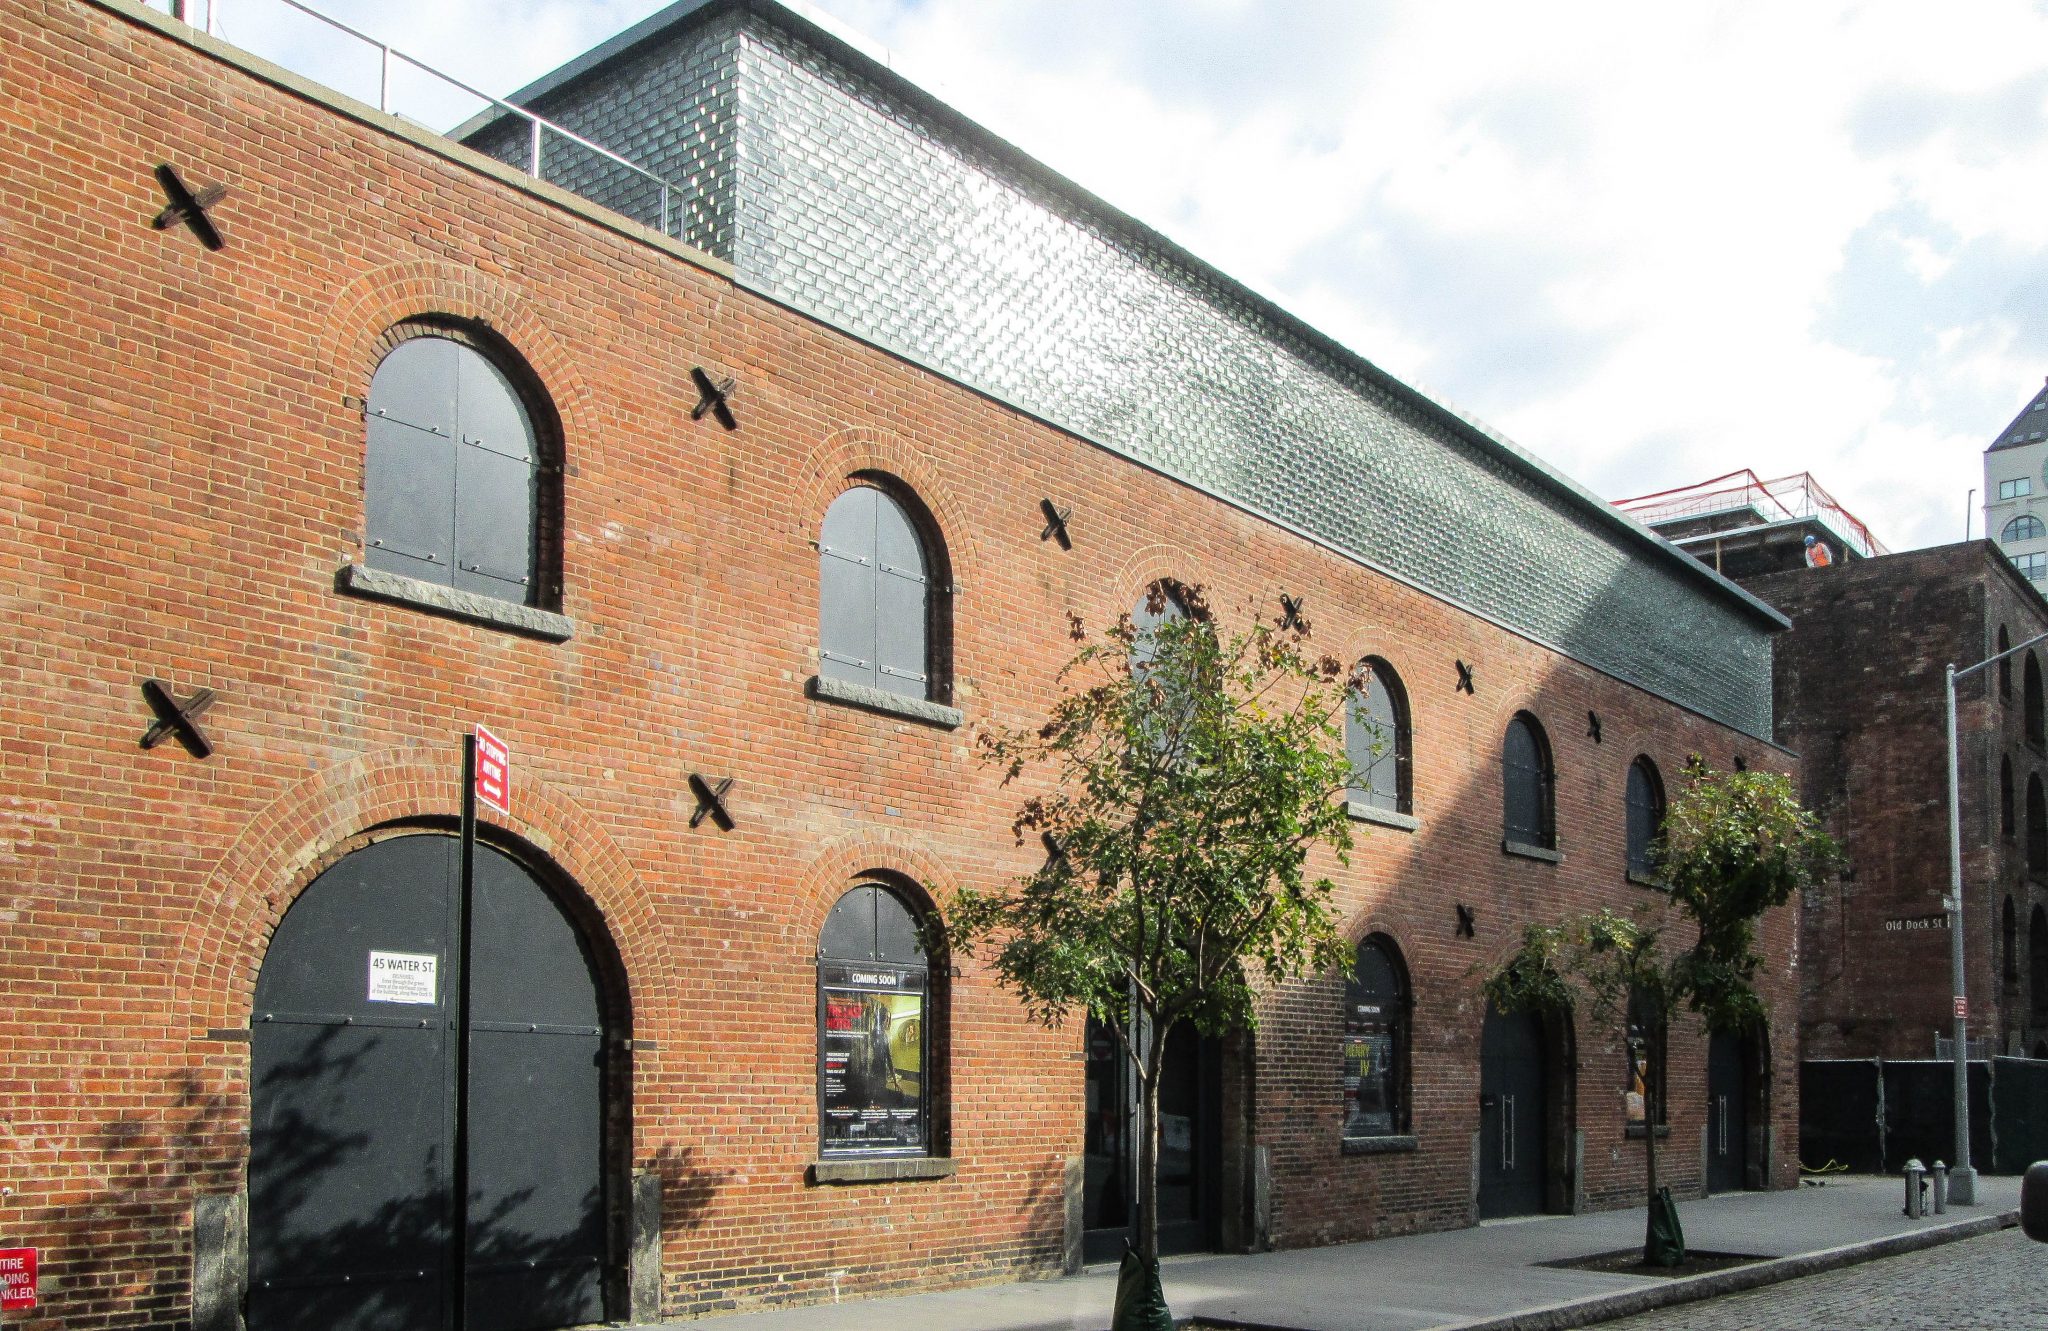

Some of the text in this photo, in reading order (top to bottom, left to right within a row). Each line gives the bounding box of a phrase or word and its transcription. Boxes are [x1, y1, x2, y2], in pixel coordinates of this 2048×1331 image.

[1885, 918, 1942, 930] Old Dock St
[372, 958, 434, 973] 45 WATER ST.
[852, 973, 897, 986] COMING SOON
[0, 1258, 24, 1270] TIRE
